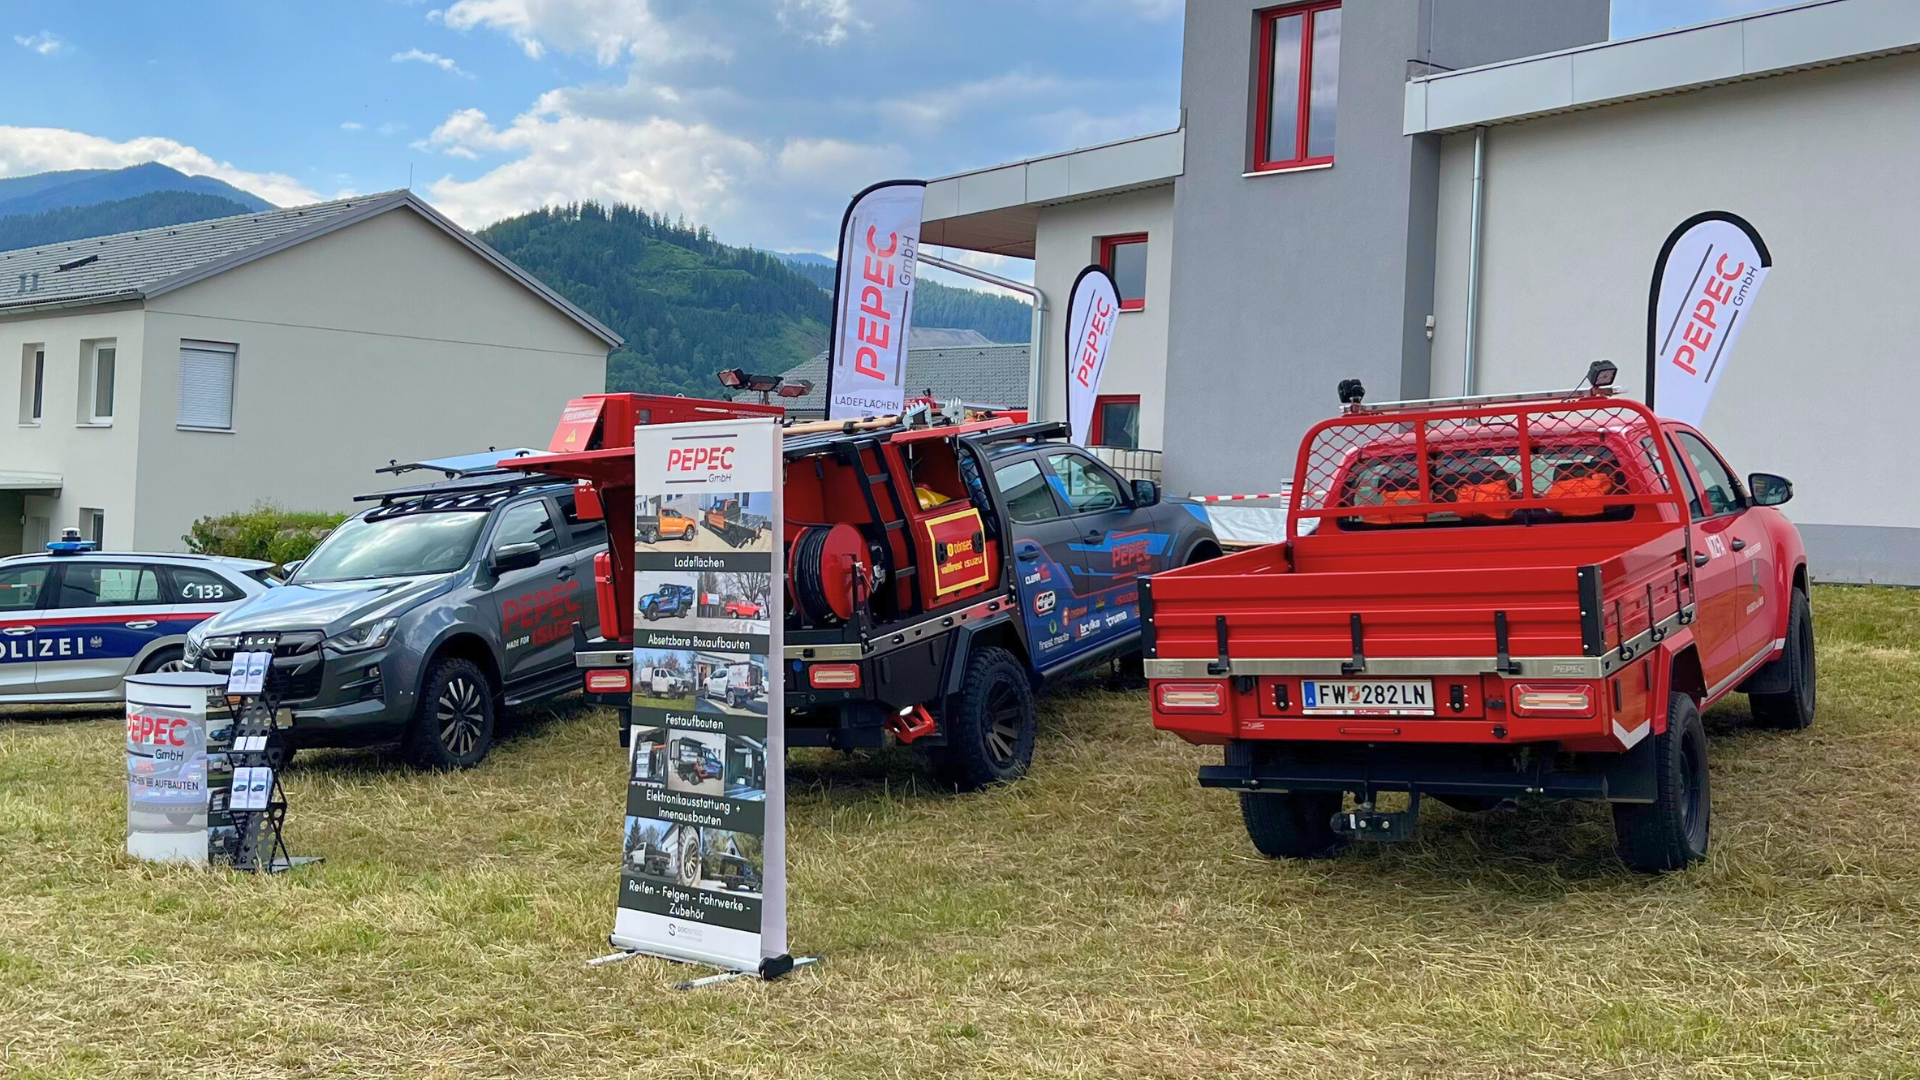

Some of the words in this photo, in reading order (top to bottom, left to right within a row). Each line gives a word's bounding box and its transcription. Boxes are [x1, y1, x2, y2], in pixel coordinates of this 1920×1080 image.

[900, 235, 915, 286] GmbH
[1733, 266, 1758, 307] GmbH
[855, 225, 898, 381] PEPEC
[1672, 253, 1744, 376] PEPEC
[1077, 297, 1111, 388] PEPEC
[835, 396, 899, 410] LADEFLÄCHEN
[667, 446, 735, 471] PEPEC
[708, 473, 732, 483] GmbH
[674, 556, 725, 568] Ladeflächen
[964, 556, 983, 568] ISUZU
[1111, 540, 1151, 568] PEPEC
[196, 585, 224, 599] 133
[502, 579, 580, 635] PEPEC
[1105, 611, 1128, 627] truma
[506, 639, 519, 650] MADE
[520, 636, 530, 646] FOR
[531, 616, 580, 647] ISUZ
[648, 633, 691, 646] Absetzbare
[693, 636, 750, 650] Boxaufbauten
[1553, 665, 1585, 673] PEPEC
[1319, 685, 1345, 704] FW
[665, 713, 724, 729] Festaufbauten
[155, 749, 184, 761] GmbH
[155, 780, 199, 791] AUFBAUTEN
[646, 789, 731, 815] Elektronikausstattung
[658, 806, 722, 826] Innenausbauten
[628, 880, 654, 895] Reifen
[662, 886, 690, 903] Felgen
[699, 893, 744, 912] Fahrwerke
[669, 903, 705, 920] Zubehör
